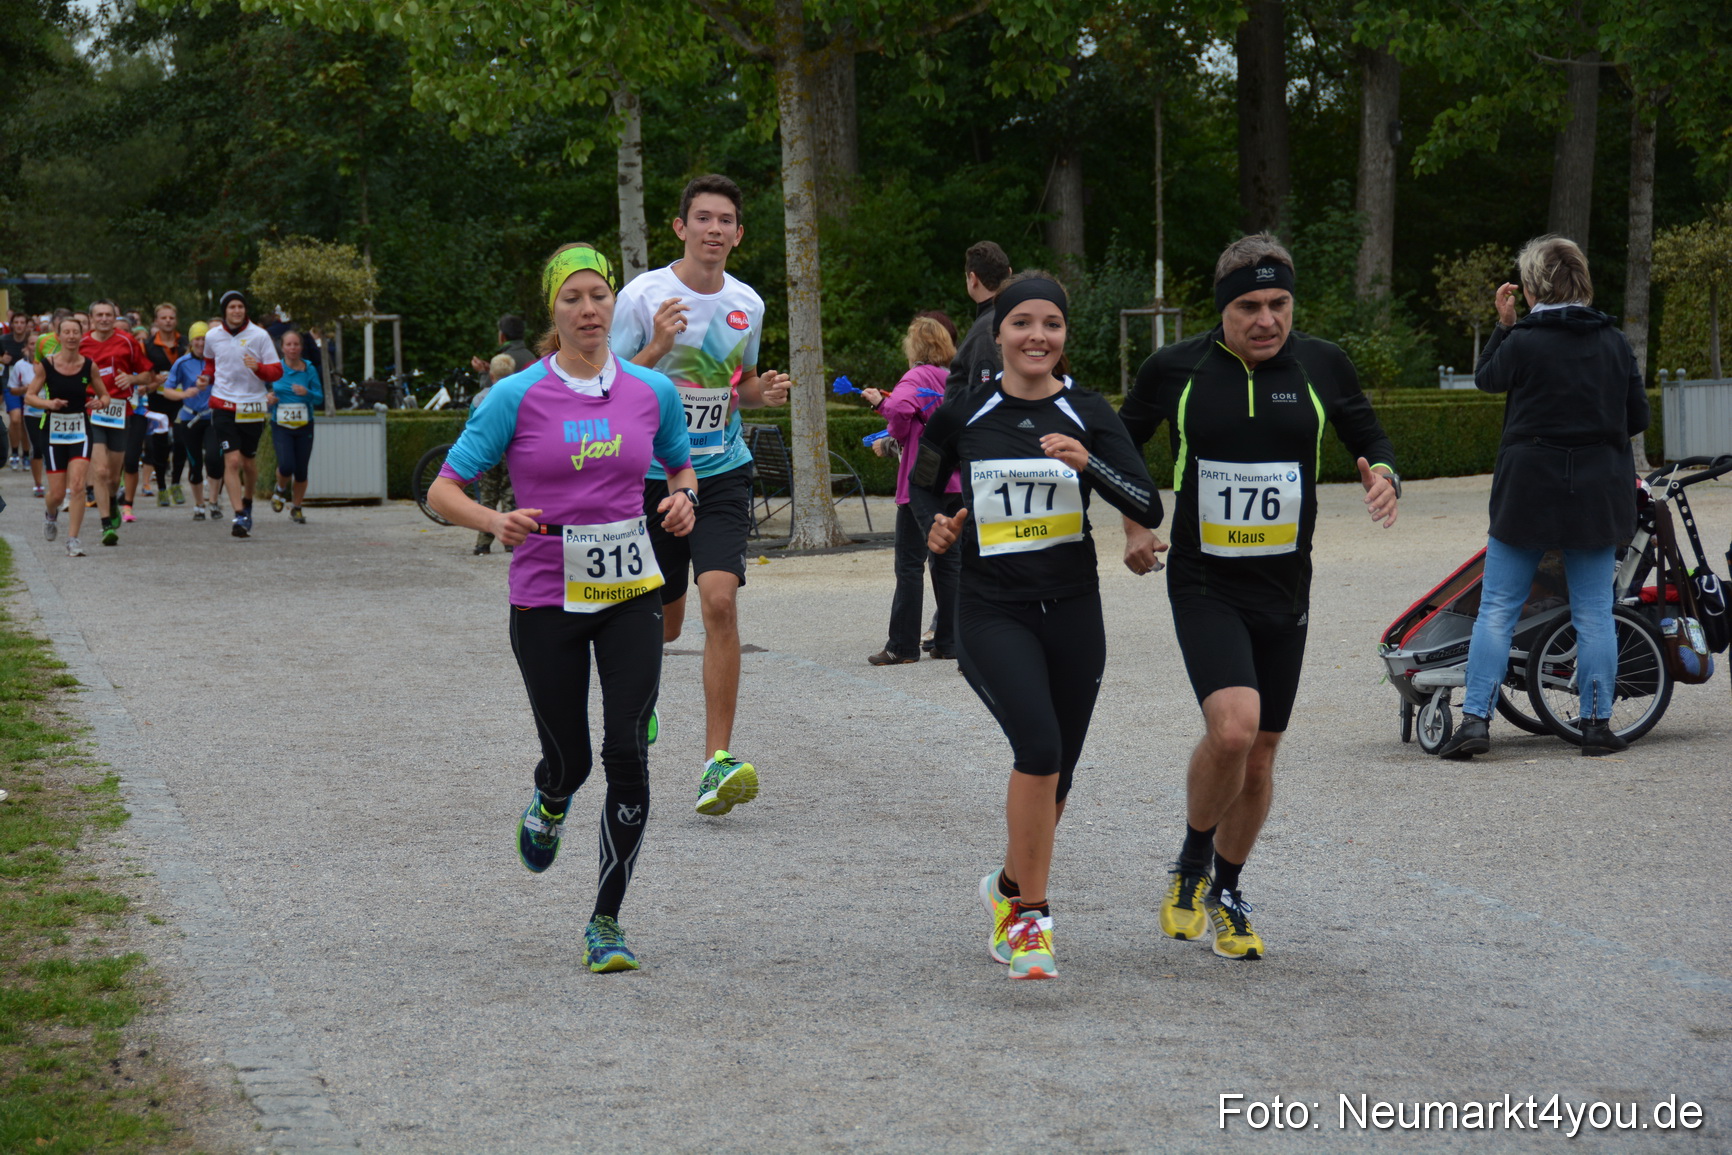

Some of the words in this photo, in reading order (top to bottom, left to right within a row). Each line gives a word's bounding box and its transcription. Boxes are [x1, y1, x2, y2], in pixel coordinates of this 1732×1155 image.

[685, 394, 720, 402] Neumarkt
[283, 410, 302, 420] 244
[54, 420, 81, 432] 2141
[563, 418, 611, 443] RUN
[571, 433, 622, 471] fast
[973, 469, 1006, 481] PARTL
[1009, 469, 1059, 478] Neumarkt
[1200, 470, 1231, 482] PARTL
[1234, 472, 1283, 482] Neumarkt
[994, 482, 1058, 517] 177
[1217, 486, 1281, 521] 176
[566, 533, 600, 543] PARTL
[603, 529, 637, 542] Neumarkt
[1015, 524, 1048, 538] Lena
[1228, 530, 1265, 544] Klaus
[586, 542, 643, 579] 313
